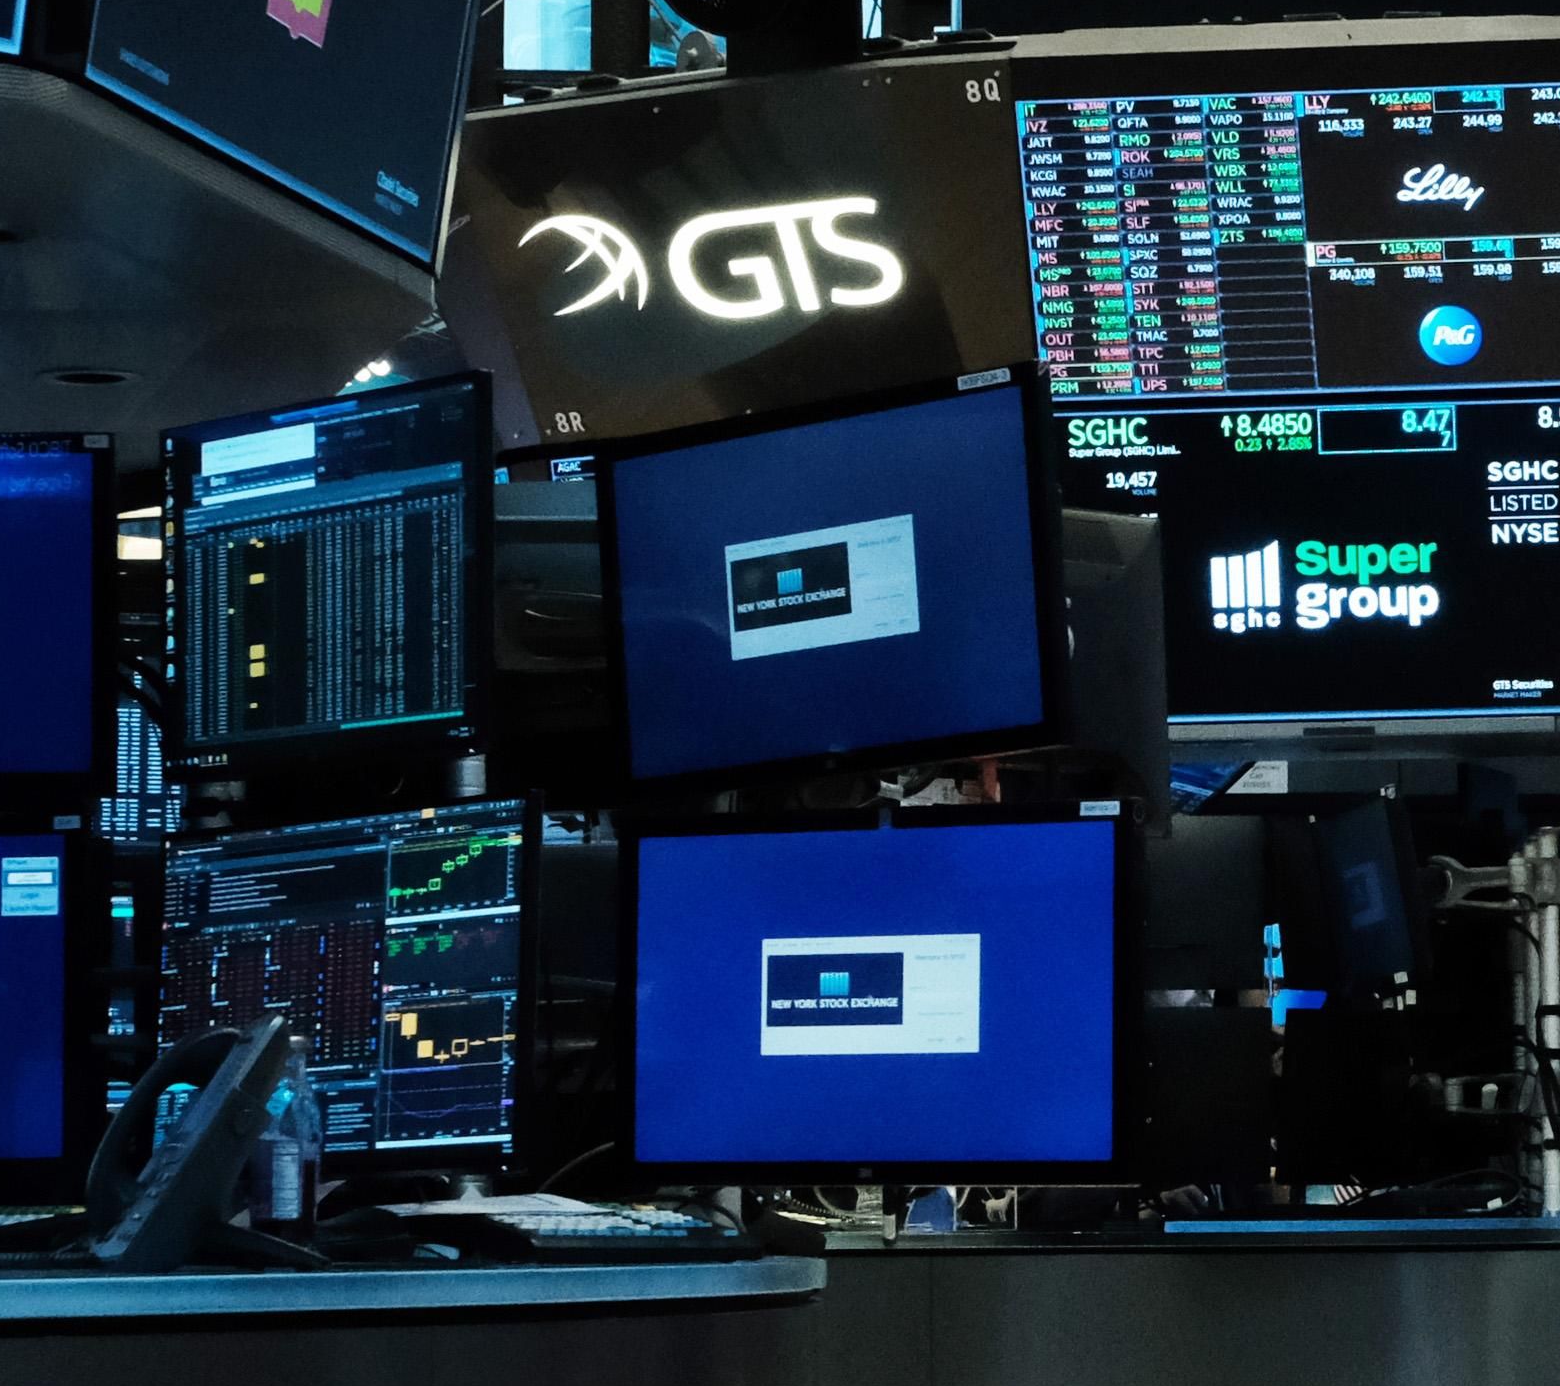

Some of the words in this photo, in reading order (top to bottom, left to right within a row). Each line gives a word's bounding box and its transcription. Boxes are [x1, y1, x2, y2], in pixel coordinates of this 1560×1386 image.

[965, 77, 1002, 104] 8Q
[1209, 97, 1237, 111] VAC
[1304, 95, 1331, 110] LLY
[1121, 150, 1151, 164] ROK
[1214, 164, 1247, 177] WBX
[1396, 163, 1486, 212] Lilly
[666, 196, 905, 320] GTS
[1315, 245, 1337, 259] PG
[1389, 241, 1442, 255] 159.7500
[1133, 298, 1160, 312] SYK
[1432, 325, 1475, 346] P&G
[1141, 379, 1168, 392] UPS
[555, 411, 586, 434] 8R
[1068, 416, 1148, 447] SGHC
[1236, 413, 1312, 437] 8.4850
[1401, 410, 1452, 434] 8.47
[1234, 438, 1262, 453] 0.23
[1105, 471, 1158, 490] 19,457
[1486, 459, 1560, 483] SGHC
[1489, 493, 1558, 512] LISTED
[1490, 523, 1560, 545] NYSE
[1295, 539, 1439, 585] Super
[737, 603, 755, 613] NEW
[756, 599, 777, 610] YORK
[778, 594, 803, 607] STOCK
[805, 587, 846, 602] EXCHANGE
[1295, 581, 1441, 630] group
[771, 1000, 792, 1009] NEW
[794, 999, 818, 1009] YORK
[820, 998, 849, 1008] STOCK
[851, 997, 898, 1008] EXCHANGE
